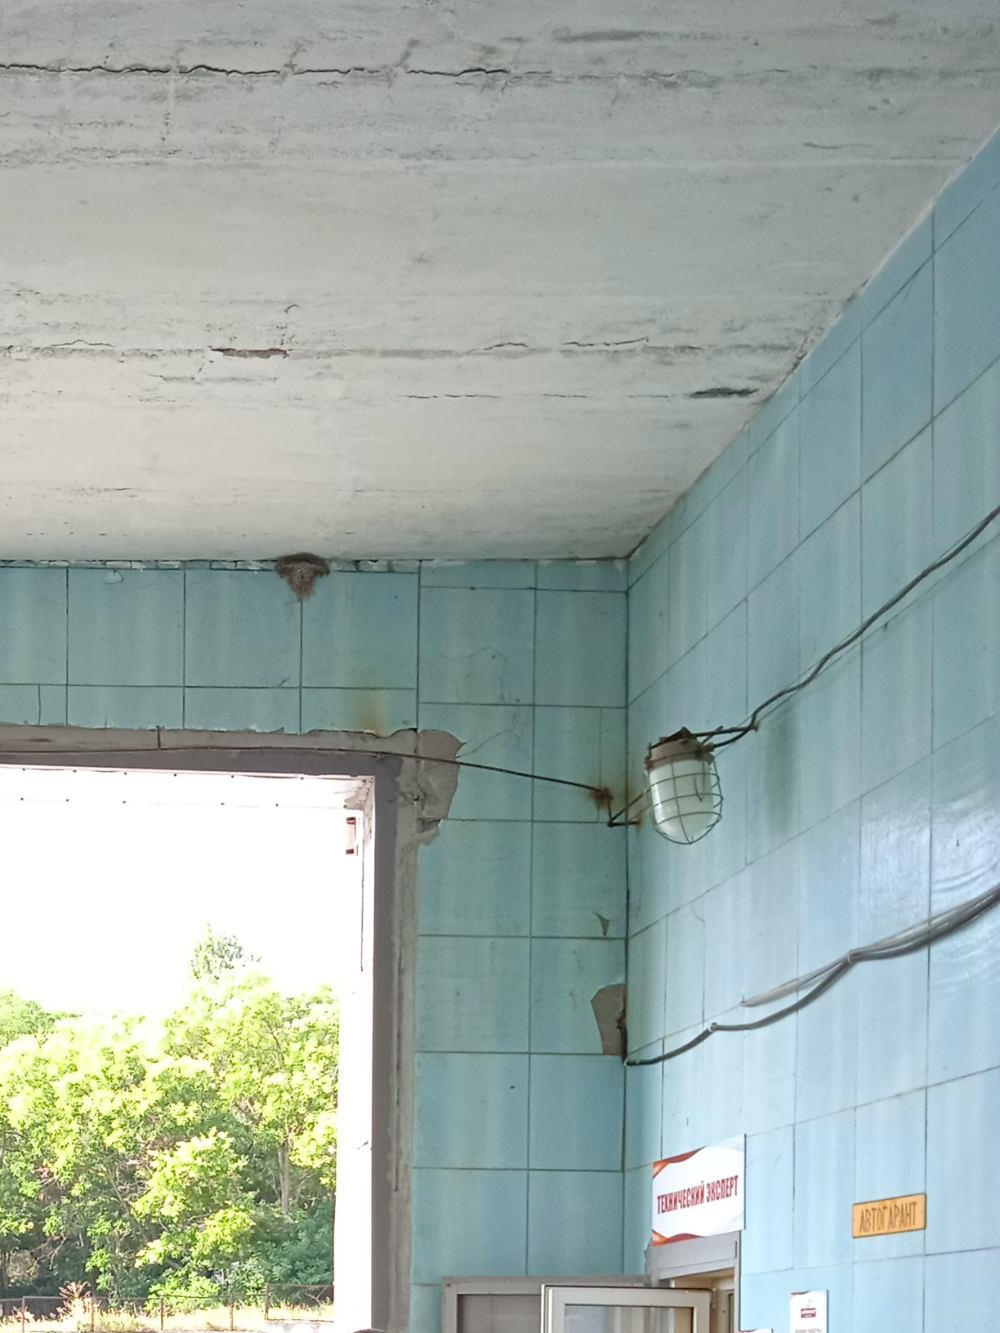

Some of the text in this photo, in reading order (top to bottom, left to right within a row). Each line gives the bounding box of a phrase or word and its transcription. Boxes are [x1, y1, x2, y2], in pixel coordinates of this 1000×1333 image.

[656, 1174, 739, 1215] ТЕХНИЧЕСКИЙ ЭКСПЕРТ
[859, 1201, 918, 1233] АВТОГАРАНТ
